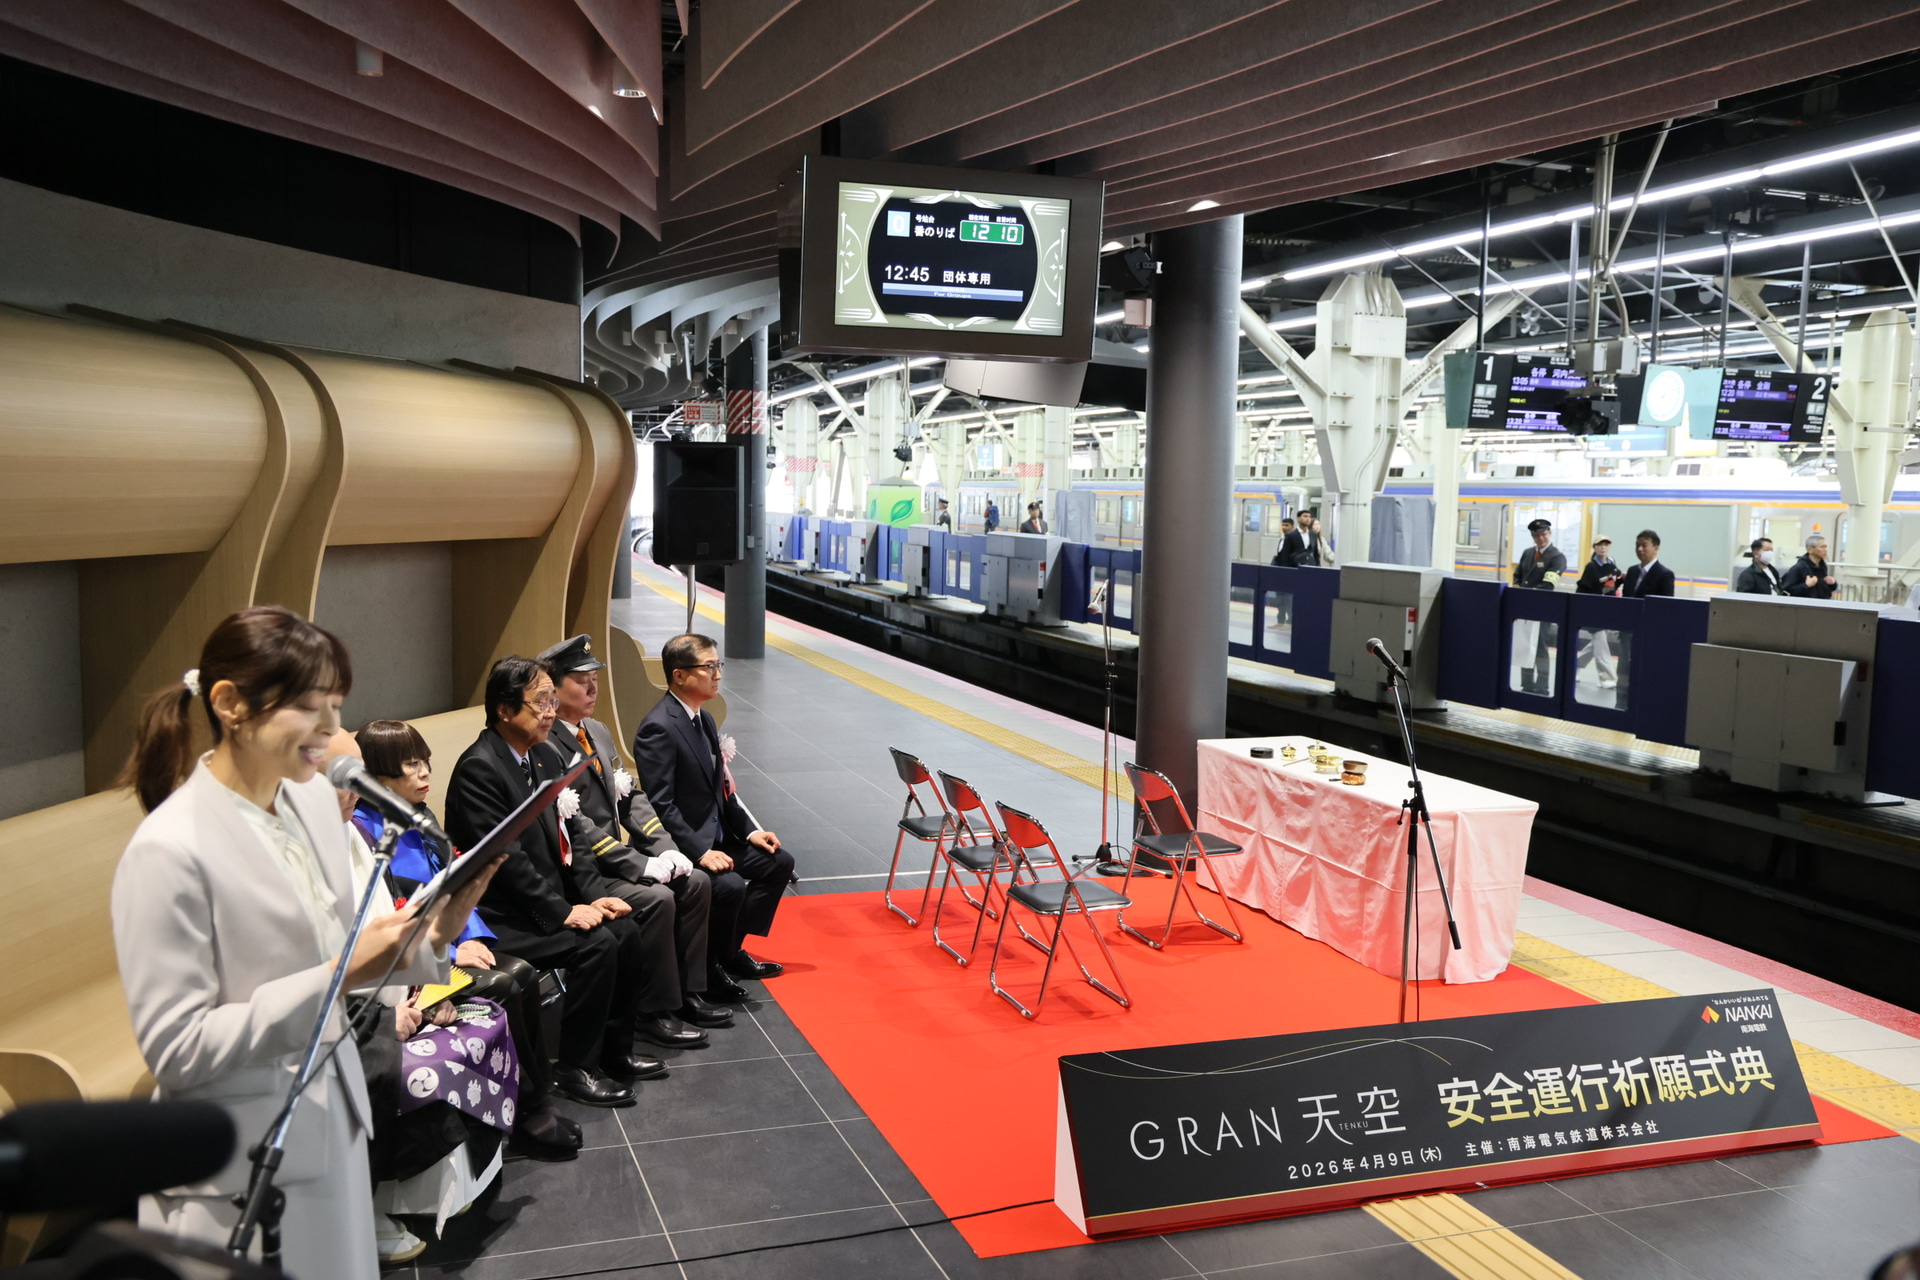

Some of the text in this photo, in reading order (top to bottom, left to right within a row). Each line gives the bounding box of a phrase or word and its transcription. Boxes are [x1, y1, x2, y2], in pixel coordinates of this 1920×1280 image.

[892, 214, 905, 234] 0
[914, 225, 956, 239] 番のりば
[972, 223, 1019, 242] 12 10
[884, 264, 991, 285] 12:45 団体専用
[1483, 355, 1495, 381] 1
[1811, 376, 1826, 400] 2
[1725, 1003, 1773, 1023] NANKAI
[1437, 1045, 1776, 1128] 安全運行祈願式典
[1129, 1086, 1407, 1160] GRAN 天空
[1338, 1120, 1369, 1131] TENKU
